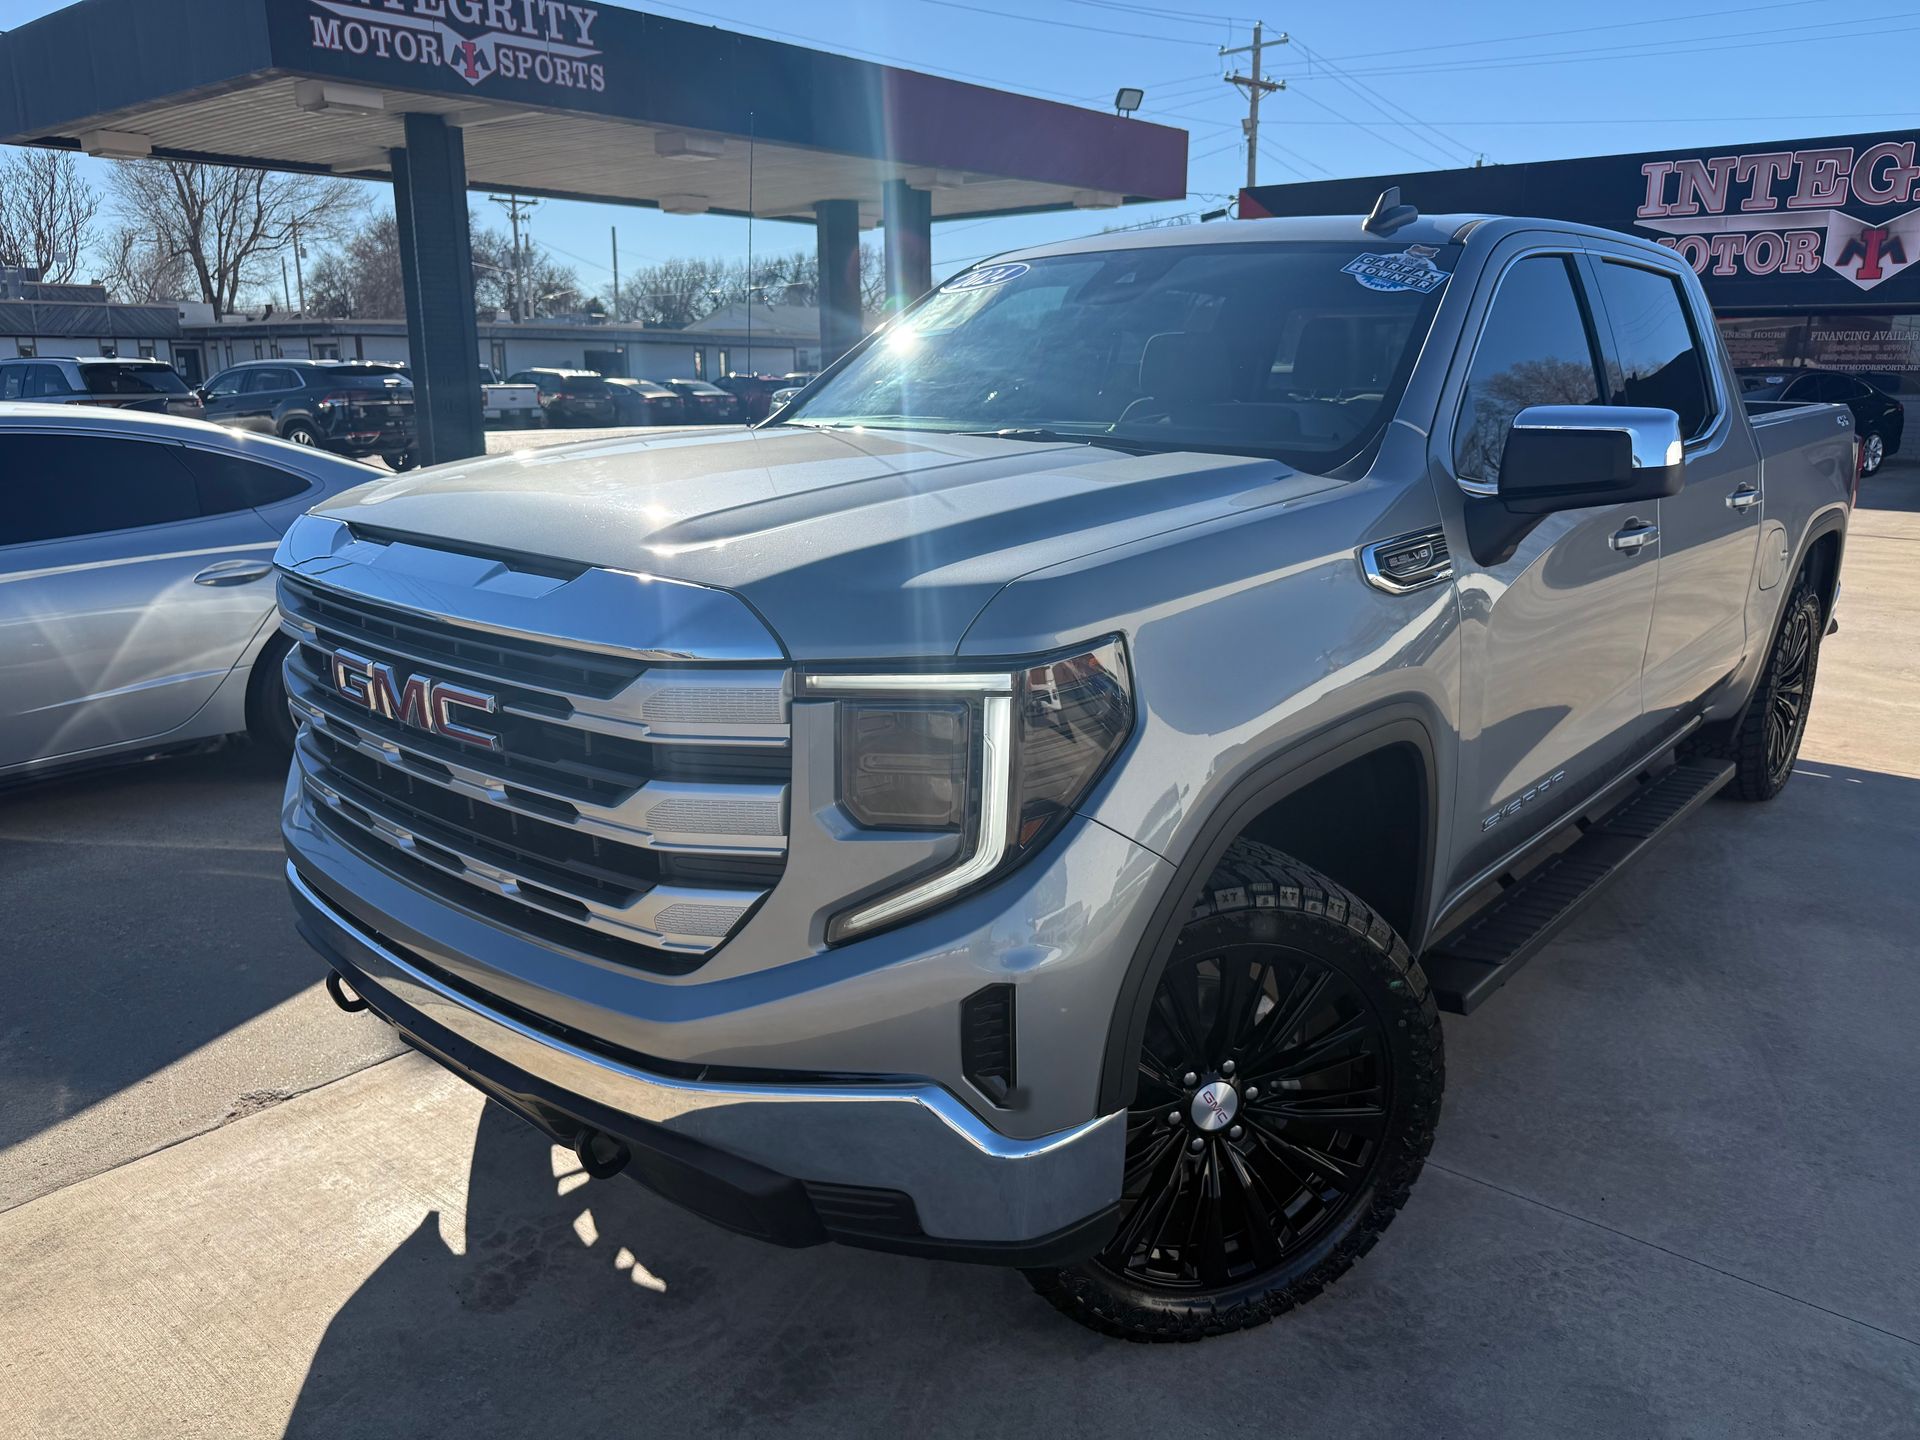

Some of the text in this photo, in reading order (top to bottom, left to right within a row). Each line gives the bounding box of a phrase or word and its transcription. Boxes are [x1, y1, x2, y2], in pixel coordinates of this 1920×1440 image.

[341, 0, 598, 46] EGRITY
[309, 15, 605, 92] MOTOR SPORTS
[1637, 141, 1920, 218] INTEG
[1352, 263, 1362, 271] 1
[1364, 266, 1431, 288] OWNER
[1362, 257, 1438, 282] CARFAX
[1657, 231, 1822, 276] OTOR
[1810, 330, 1870, 341] FINANCING
[331, 648, 498, 751] GMC
[1202, 1090, 1228, 1124] GMC
